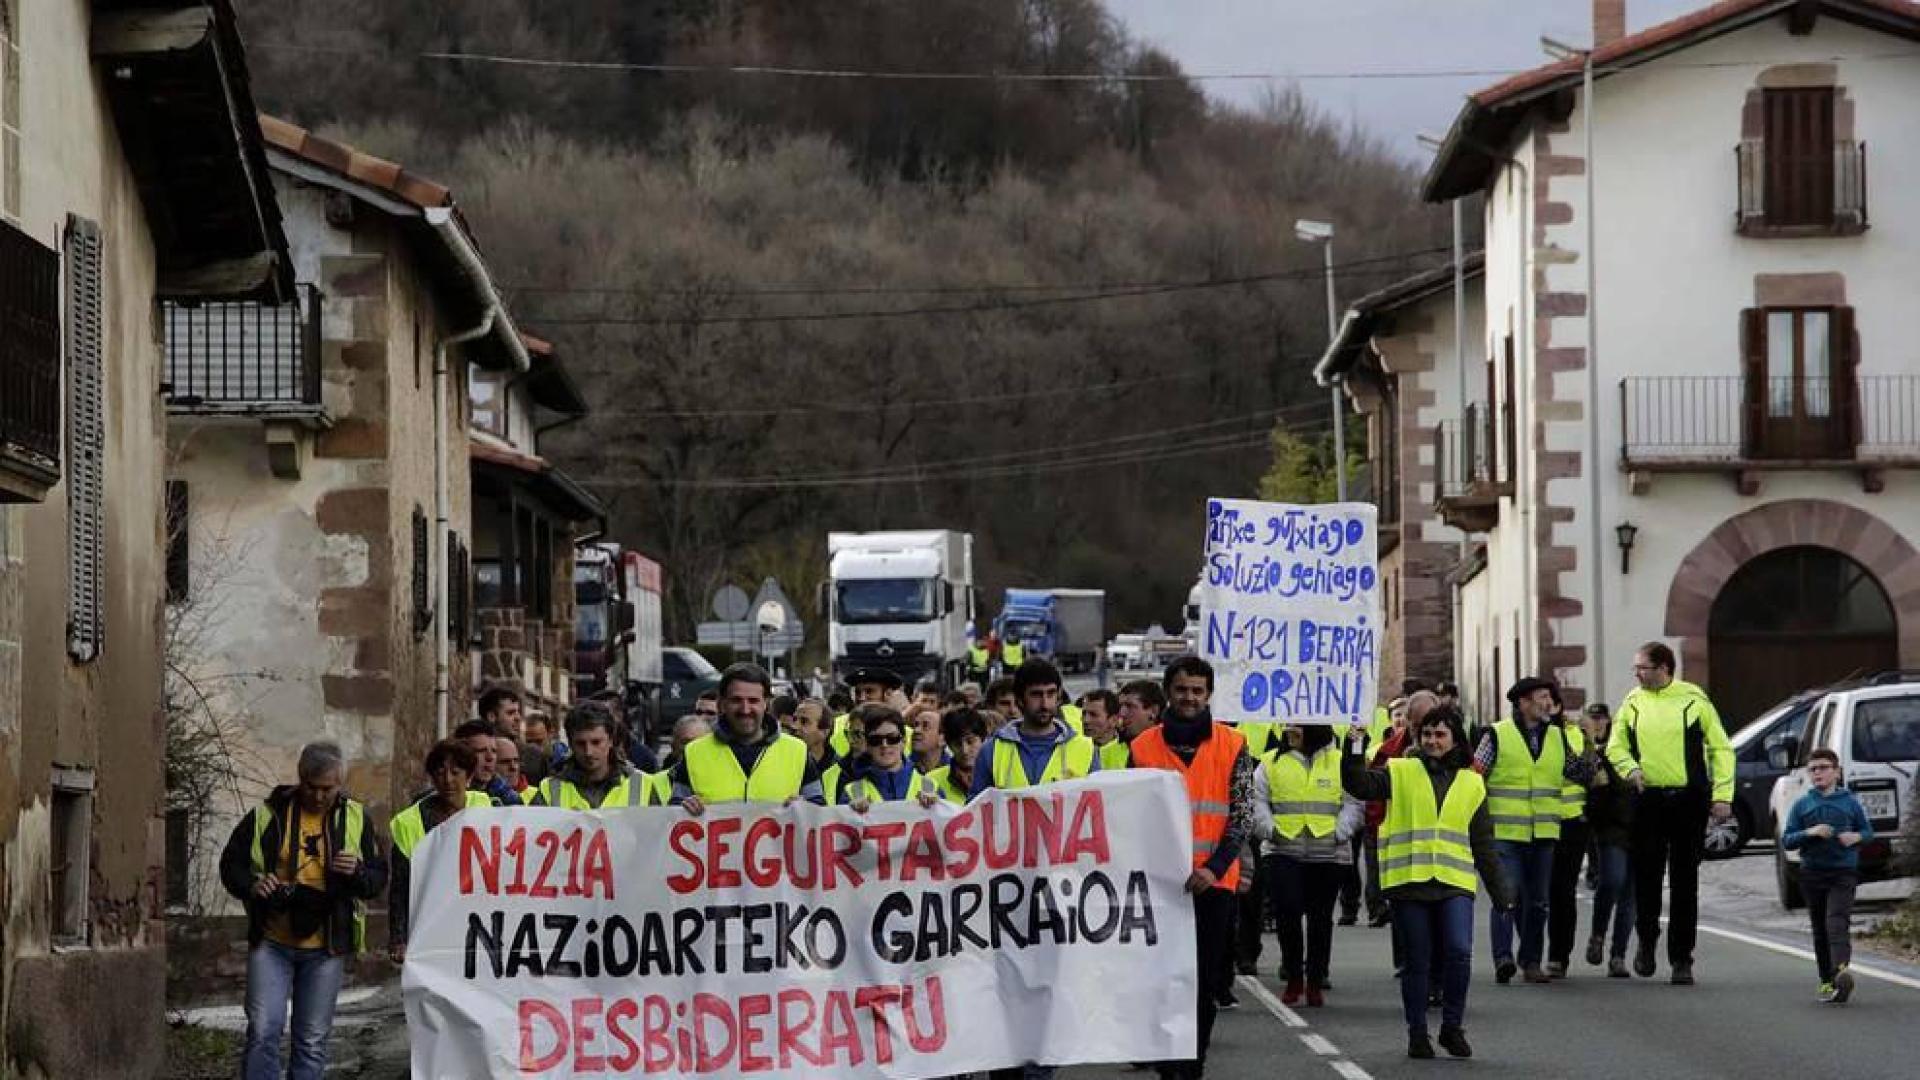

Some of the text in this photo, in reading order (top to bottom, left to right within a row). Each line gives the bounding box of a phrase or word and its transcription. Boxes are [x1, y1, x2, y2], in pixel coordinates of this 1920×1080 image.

[1208, 611, 1290, 665] N-121
[459, 790, 1110, 900] N121A SEGURTASUNA
